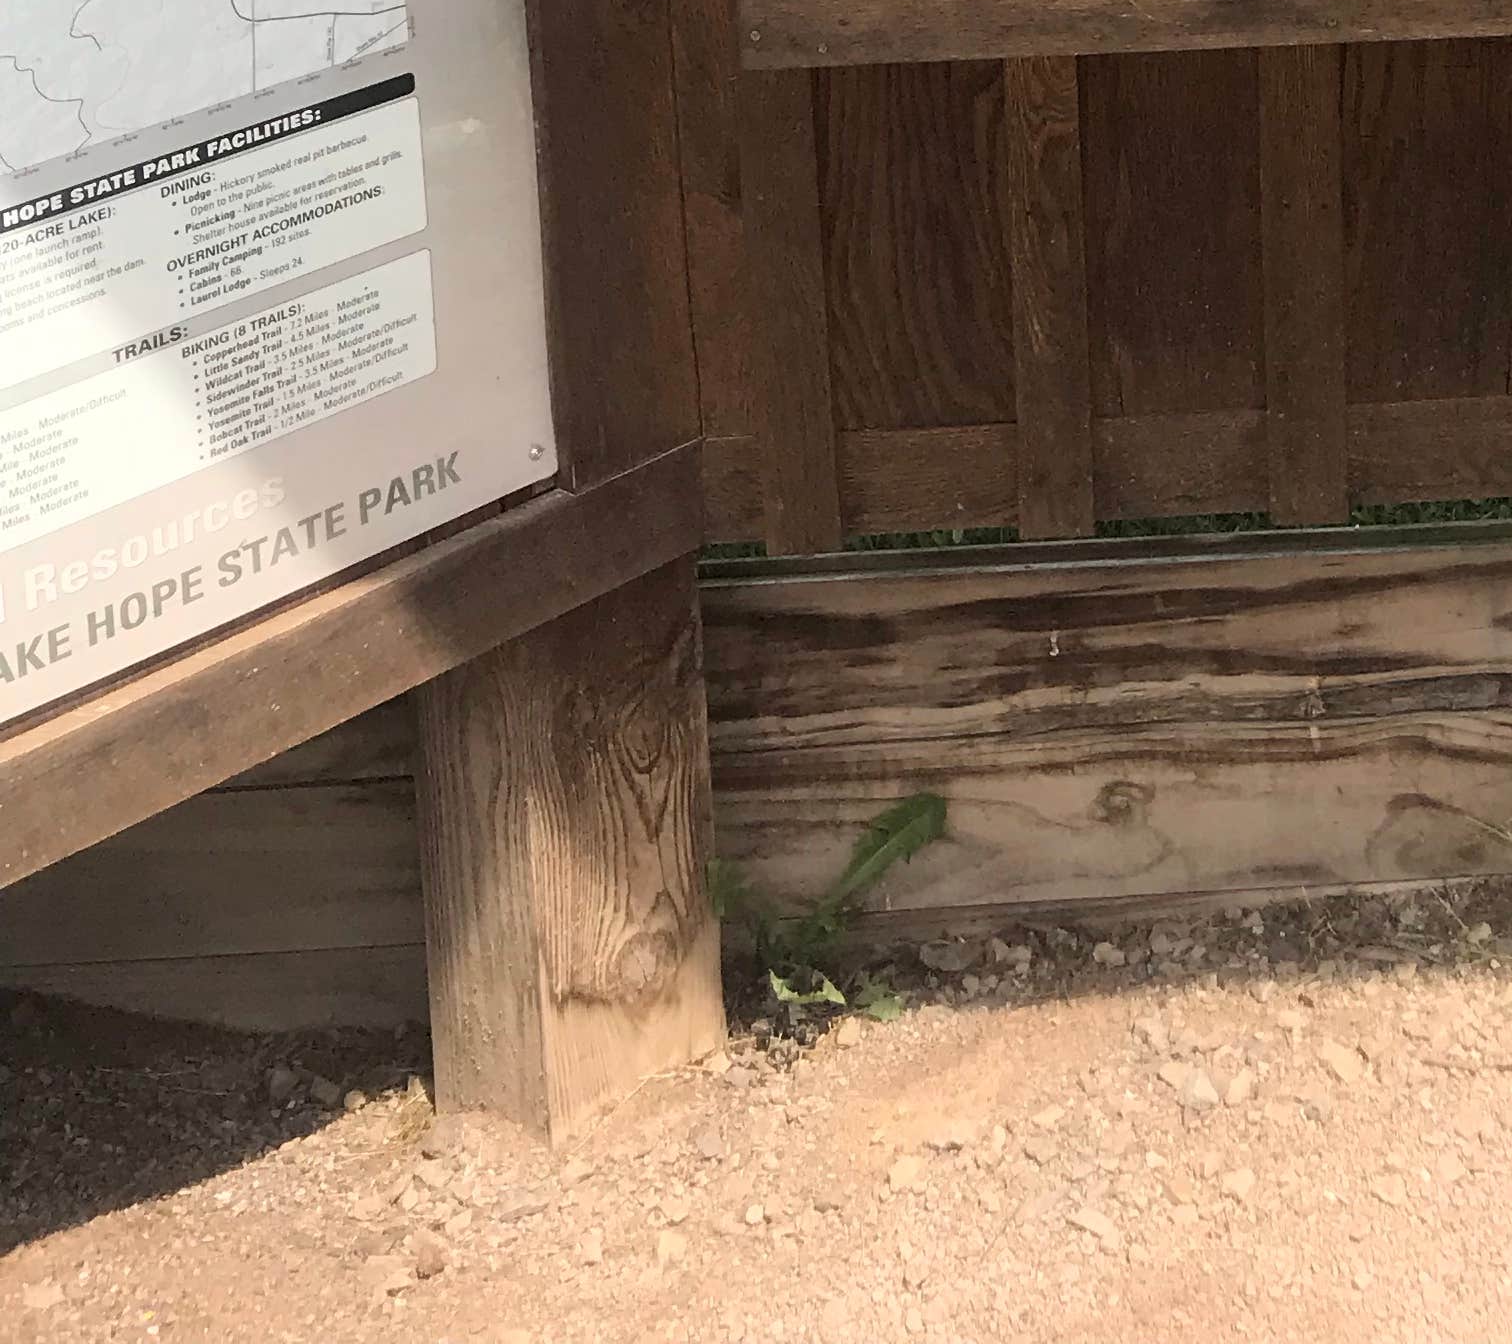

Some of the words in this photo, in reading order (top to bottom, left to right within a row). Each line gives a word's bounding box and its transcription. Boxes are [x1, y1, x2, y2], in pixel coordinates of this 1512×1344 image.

[2, 194, 62, 228] HOPE
[70, 171, 136, 203] STATE
[143, 147, 200, 178] PARK
[206, 109, 321, 156] FACILITIES:
[160, 172, 216, 198] DINING:
[166, 233, 247, 271] OVERNIGHT
[253, 185, 385, 239] ACCOMMODATIONS:
[112, 325, 189, 363] TRAILS:
[25, 477, 288, 610] Resources
[87, 565, 205, 647] HOPE
[218, 501, 348, 589] STATE
[359, 452, 462, 526] PARK
